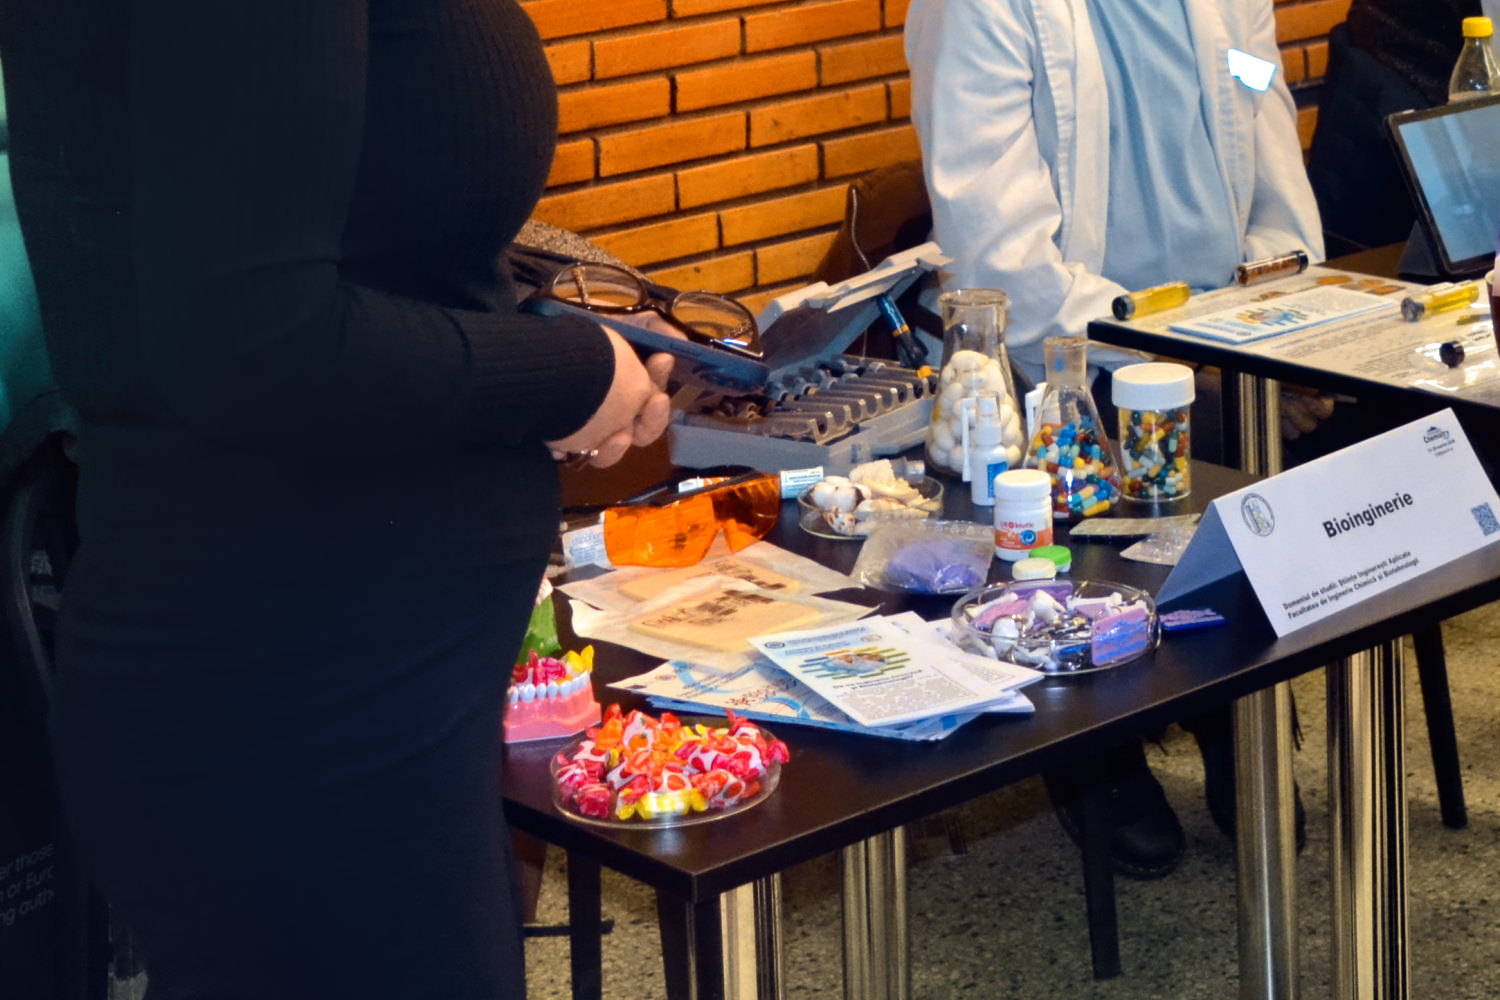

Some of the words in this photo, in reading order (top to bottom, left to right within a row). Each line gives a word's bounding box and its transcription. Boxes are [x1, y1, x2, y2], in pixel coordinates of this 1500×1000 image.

[1322, 492, 1414, 539] Bioinginerie
[1283, 593, 1311, 610] Domeniul
[1288, 601, 1319, 619] Facultatea
[1328, 587, 1354, 602] Inginerie
[1383, 557, 1419, 577] Biotehnologii
